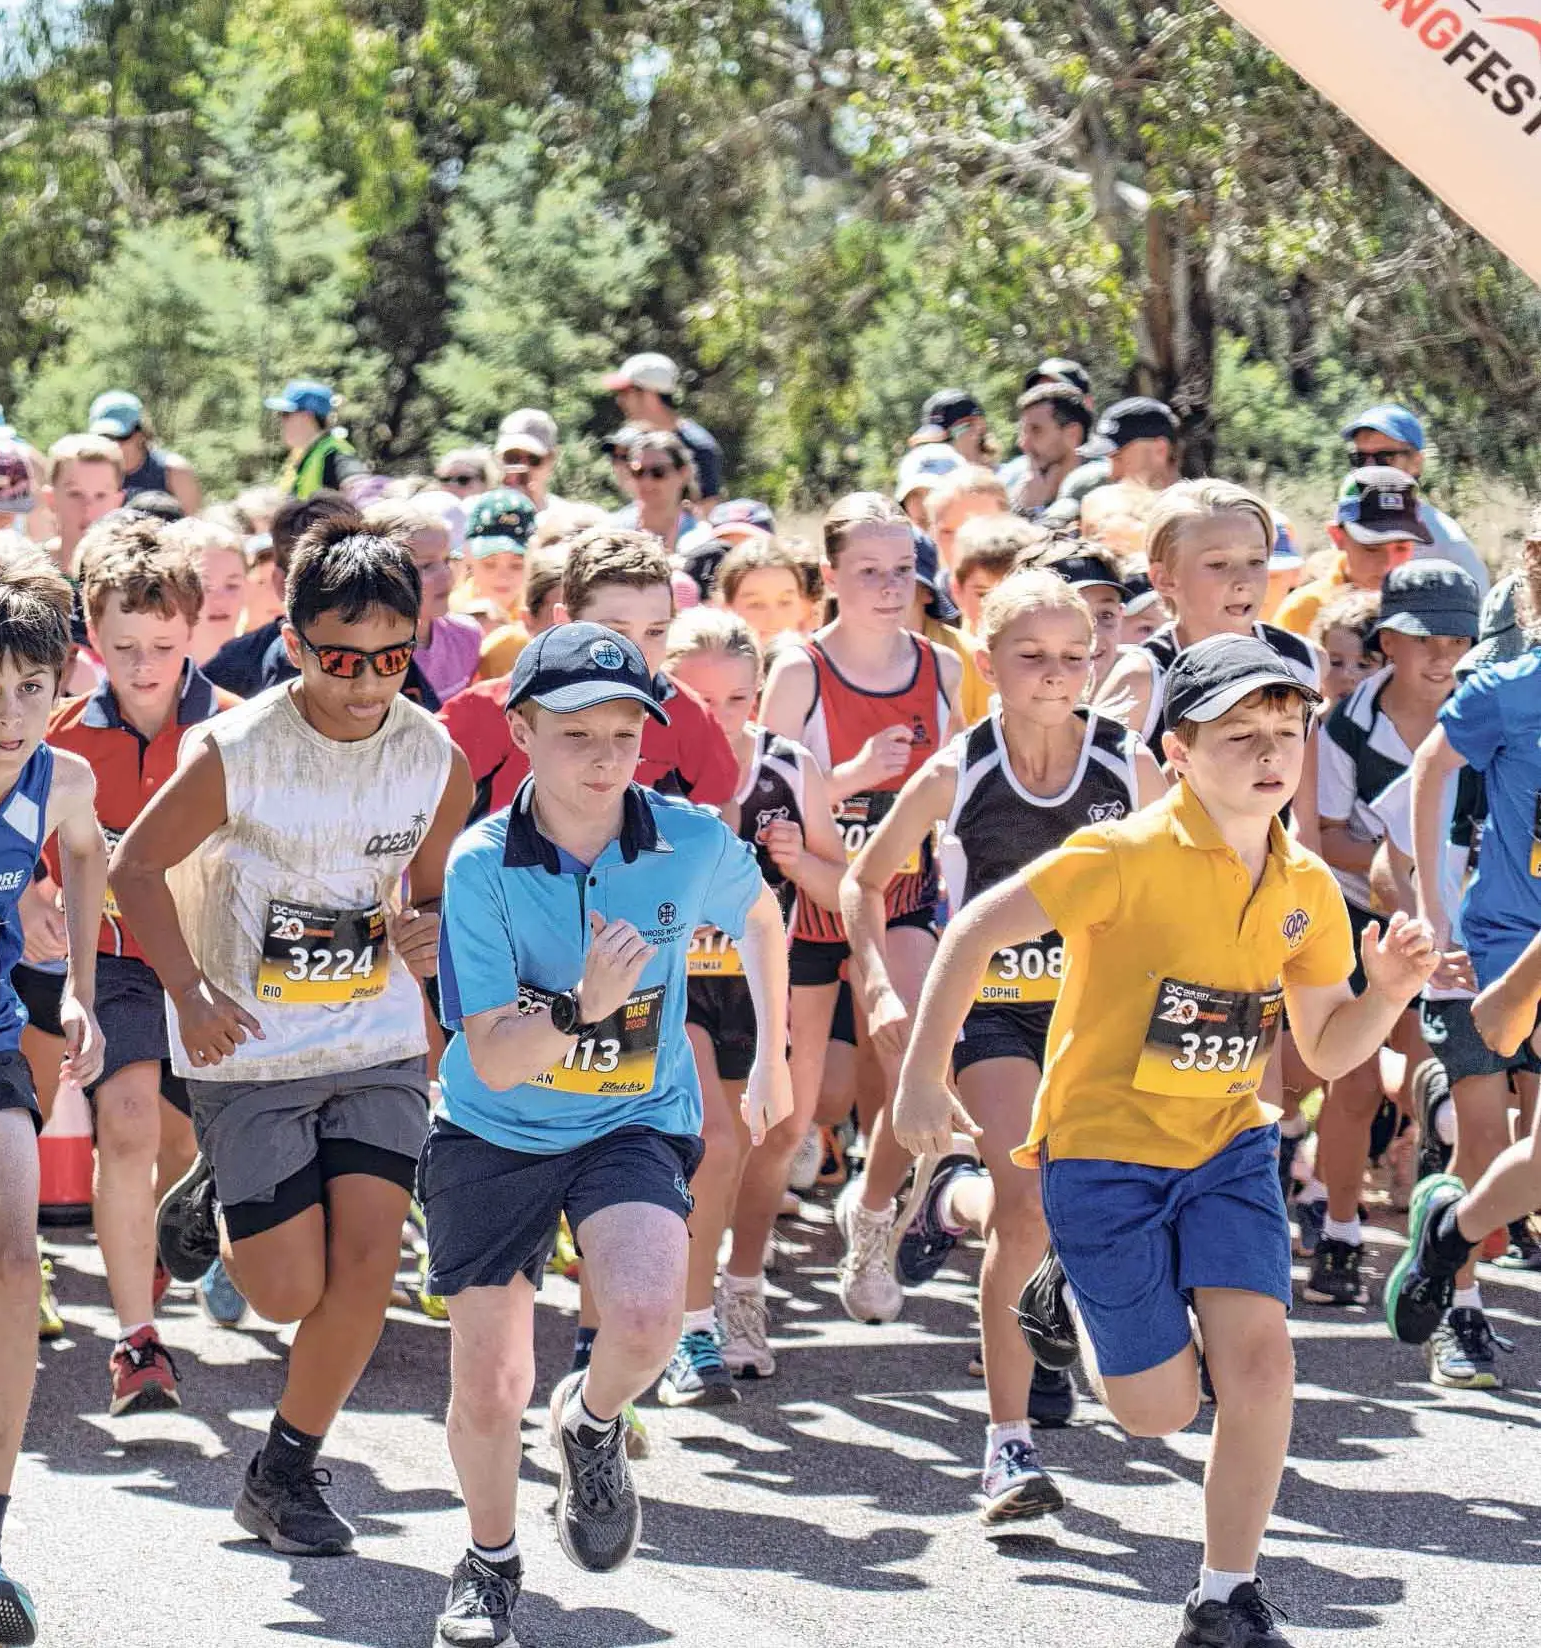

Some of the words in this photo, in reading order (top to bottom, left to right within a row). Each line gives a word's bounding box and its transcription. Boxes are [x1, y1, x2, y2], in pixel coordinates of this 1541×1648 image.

[269, 915, 304, 940] 20
[638, 929, 665, 938] INROSS
[285, 945, 374, 981] 3224
[263, 985, 282, 998] RIO
[982, 986, 1021, 998] SOPHIE
[626, 1001, 650, 1018] DASH
[1158, 996, 1198, 1025] 20
[1171, 1033, 1258, 1072] 3331
[531, 1073, 555, 1084] AN
